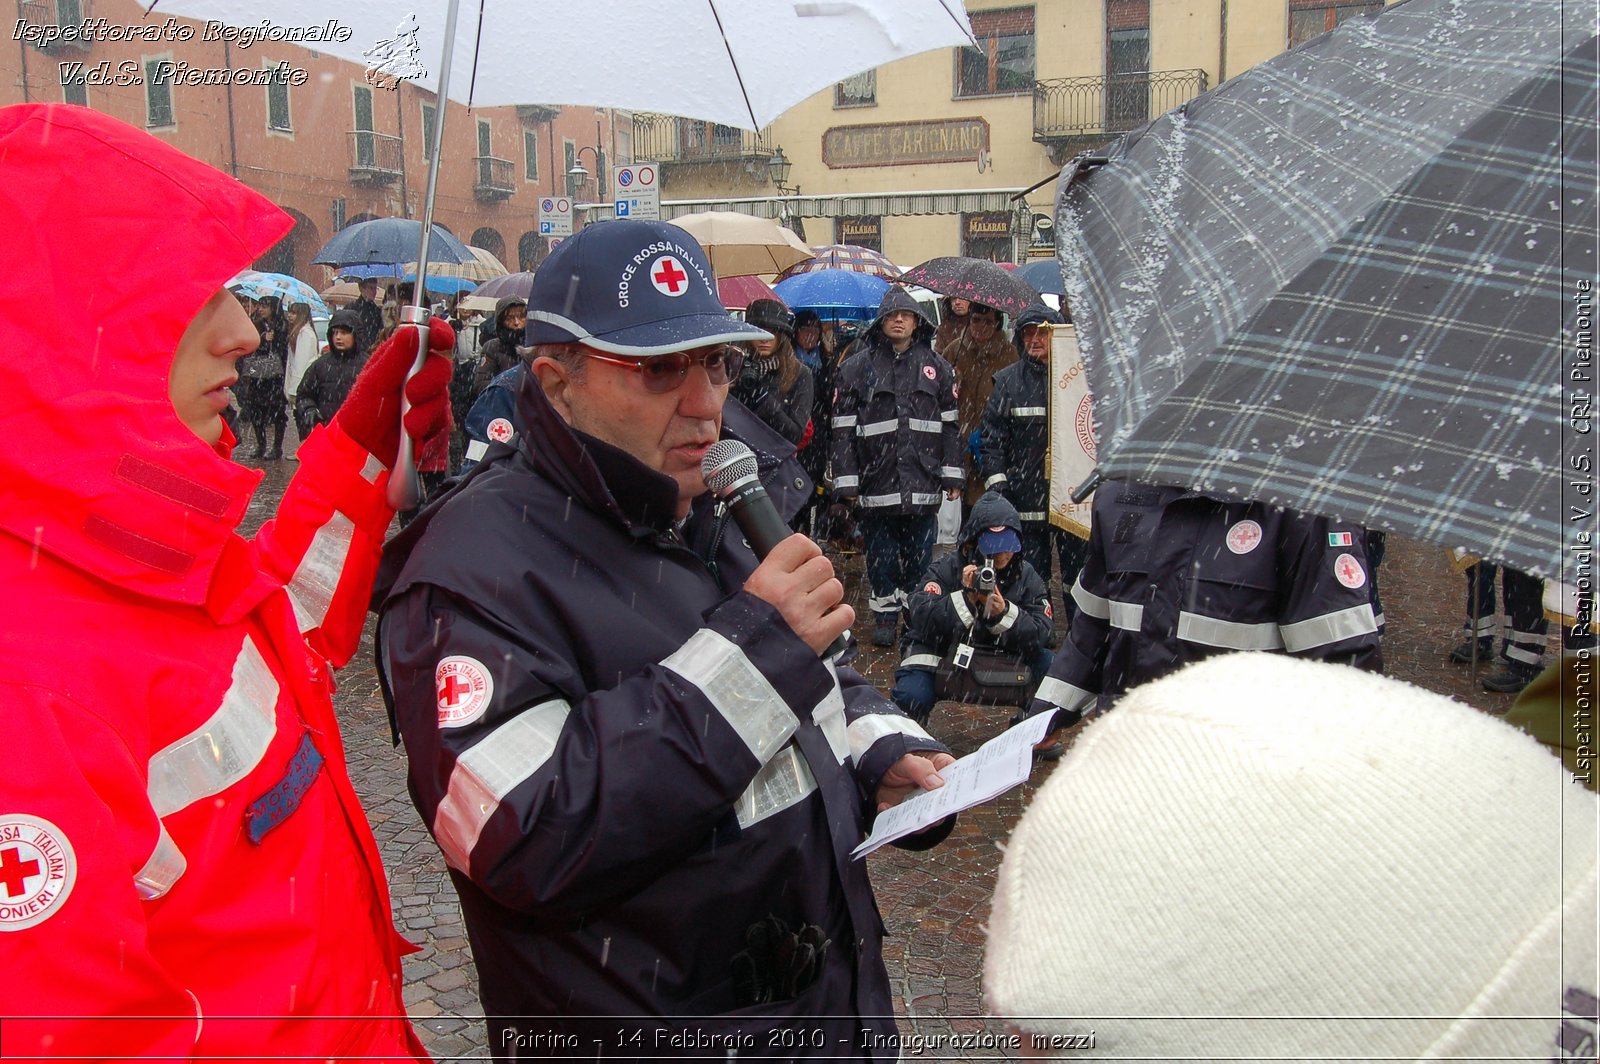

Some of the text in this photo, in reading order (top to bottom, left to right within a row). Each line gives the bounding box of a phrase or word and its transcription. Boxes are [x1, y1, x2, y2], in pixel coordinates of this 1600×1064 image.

[889, 126, 980, 154] CARIGNANO
[842, 224, 878, 234] MALABAR
[970, 220, 1007, 232] MALABAR
[618, 241, 713, 308] CROCE ROSSA ITALIANA
[460, 664, 484, 692] ITALIANA
[33, 832, 64, 881] ITALIANA
